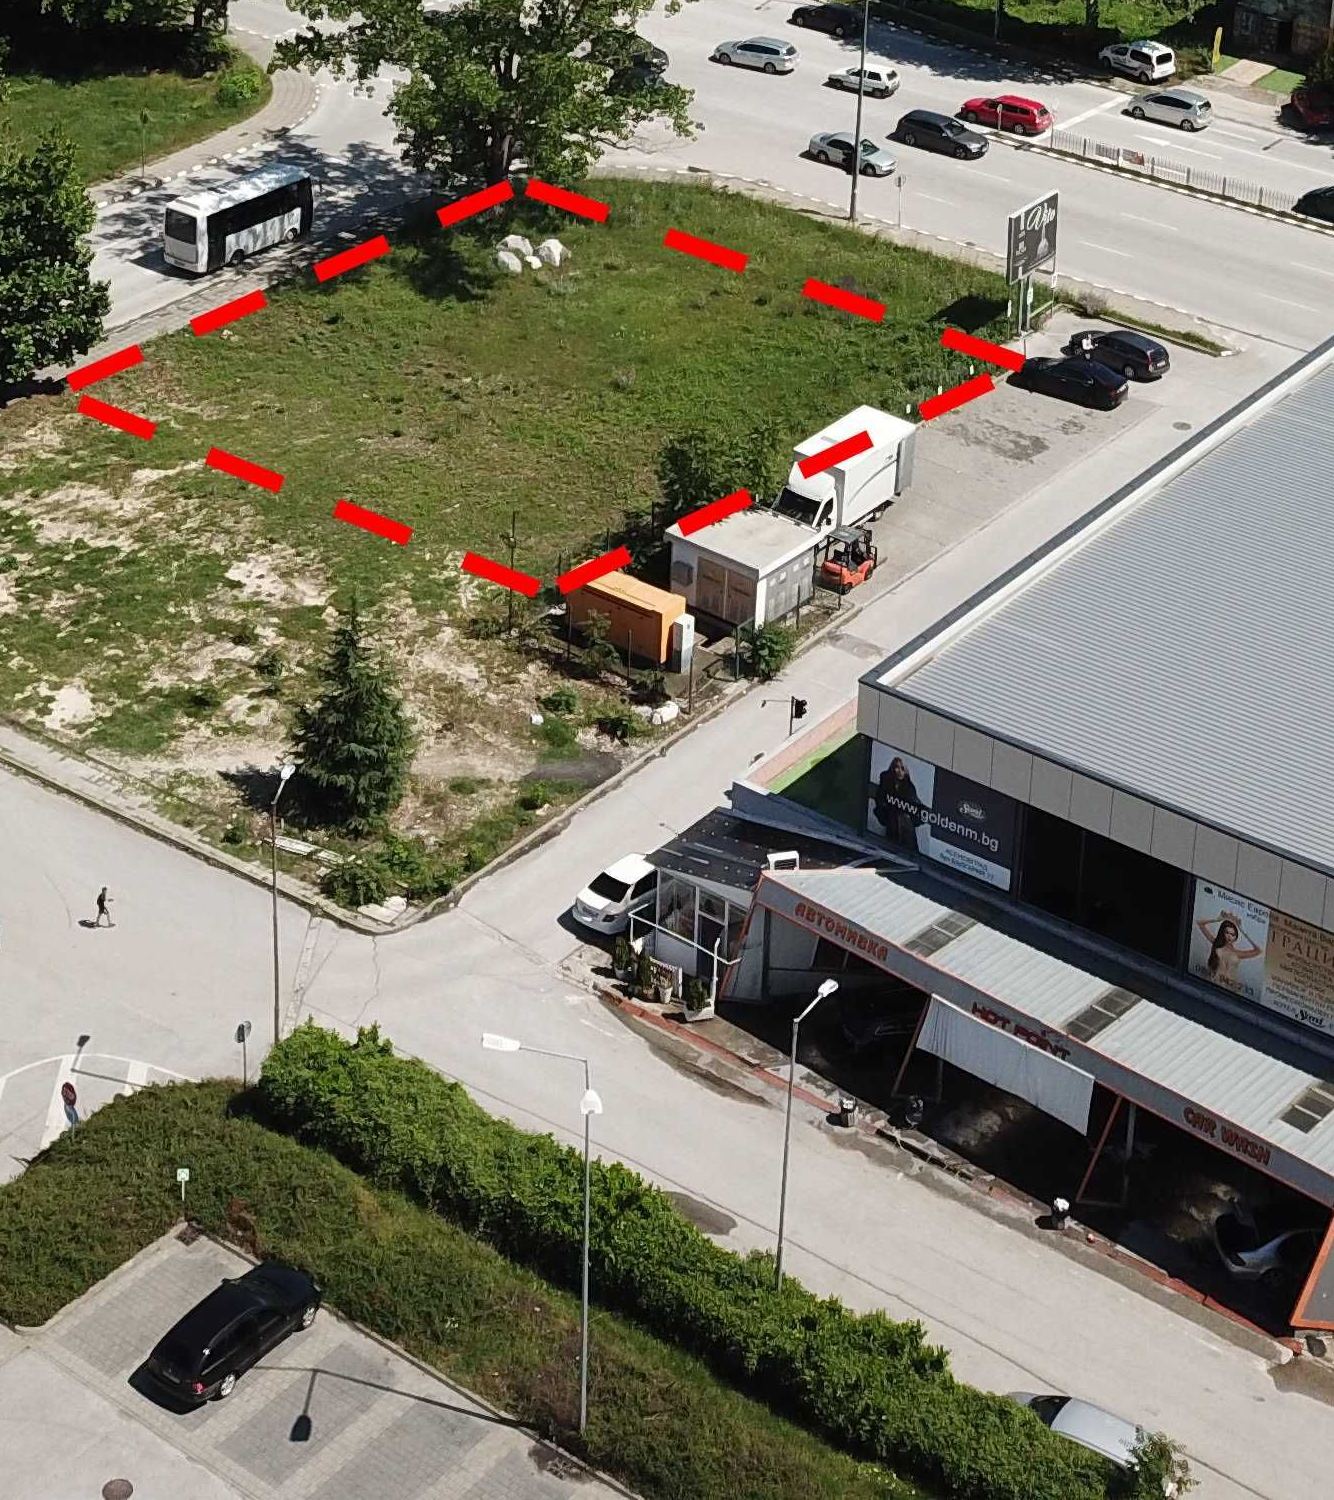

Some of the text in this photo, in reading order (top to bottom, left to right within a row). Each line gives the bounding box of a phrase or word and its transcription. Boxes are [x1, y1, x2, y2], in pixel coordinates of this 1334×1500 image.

[885, 793, 1000, 852] www.goldenm.bg
[794, 902, 888, 961] АВТОМИВКА
[971, 1001, 1071, 1060] HOT POINT
[1183, 1106, 1272, 1166] CAR WASH
